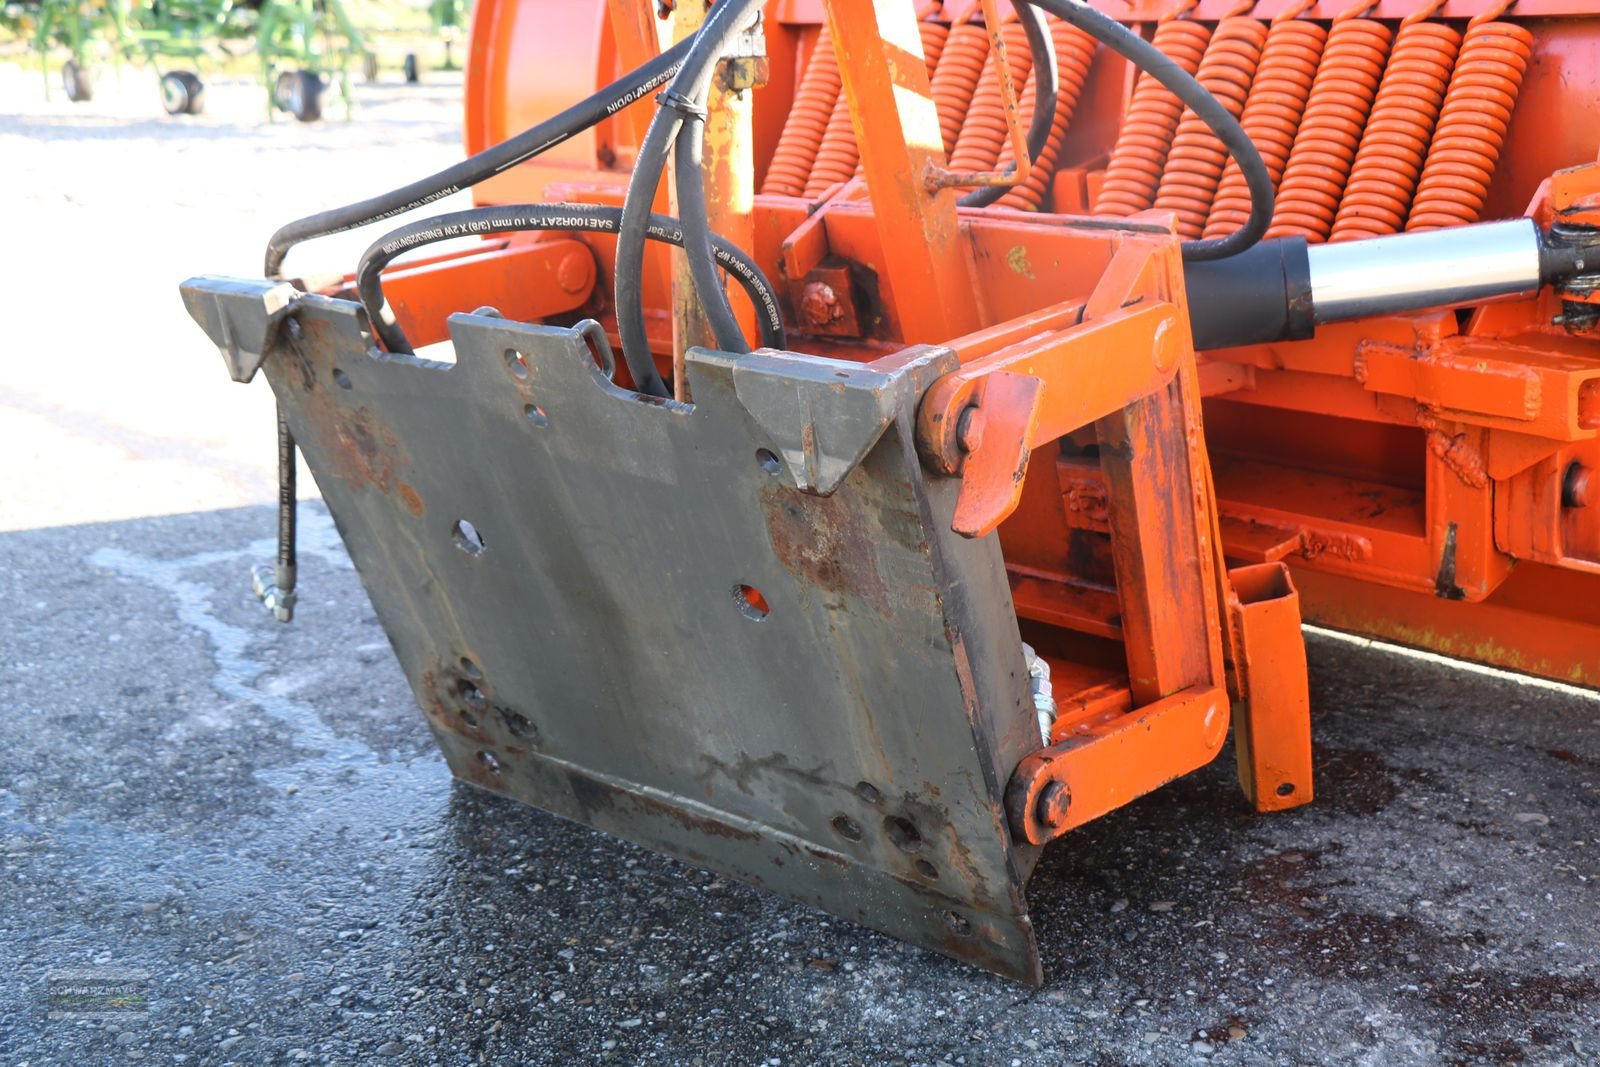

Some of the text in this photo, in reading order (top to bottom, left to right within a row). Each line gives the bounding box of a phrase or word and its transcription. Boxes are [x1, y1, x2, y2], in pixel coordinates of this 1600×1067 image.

[460, 223, 468, 233] X
[467, 219, 491, 233] (3/8)
[491, 217, 513, 228] mm
[445, 224, 460, 236] 2W
[749, 275, 772, 305] NO-SKIVE
[766, 301, 781, 332] PARKER
